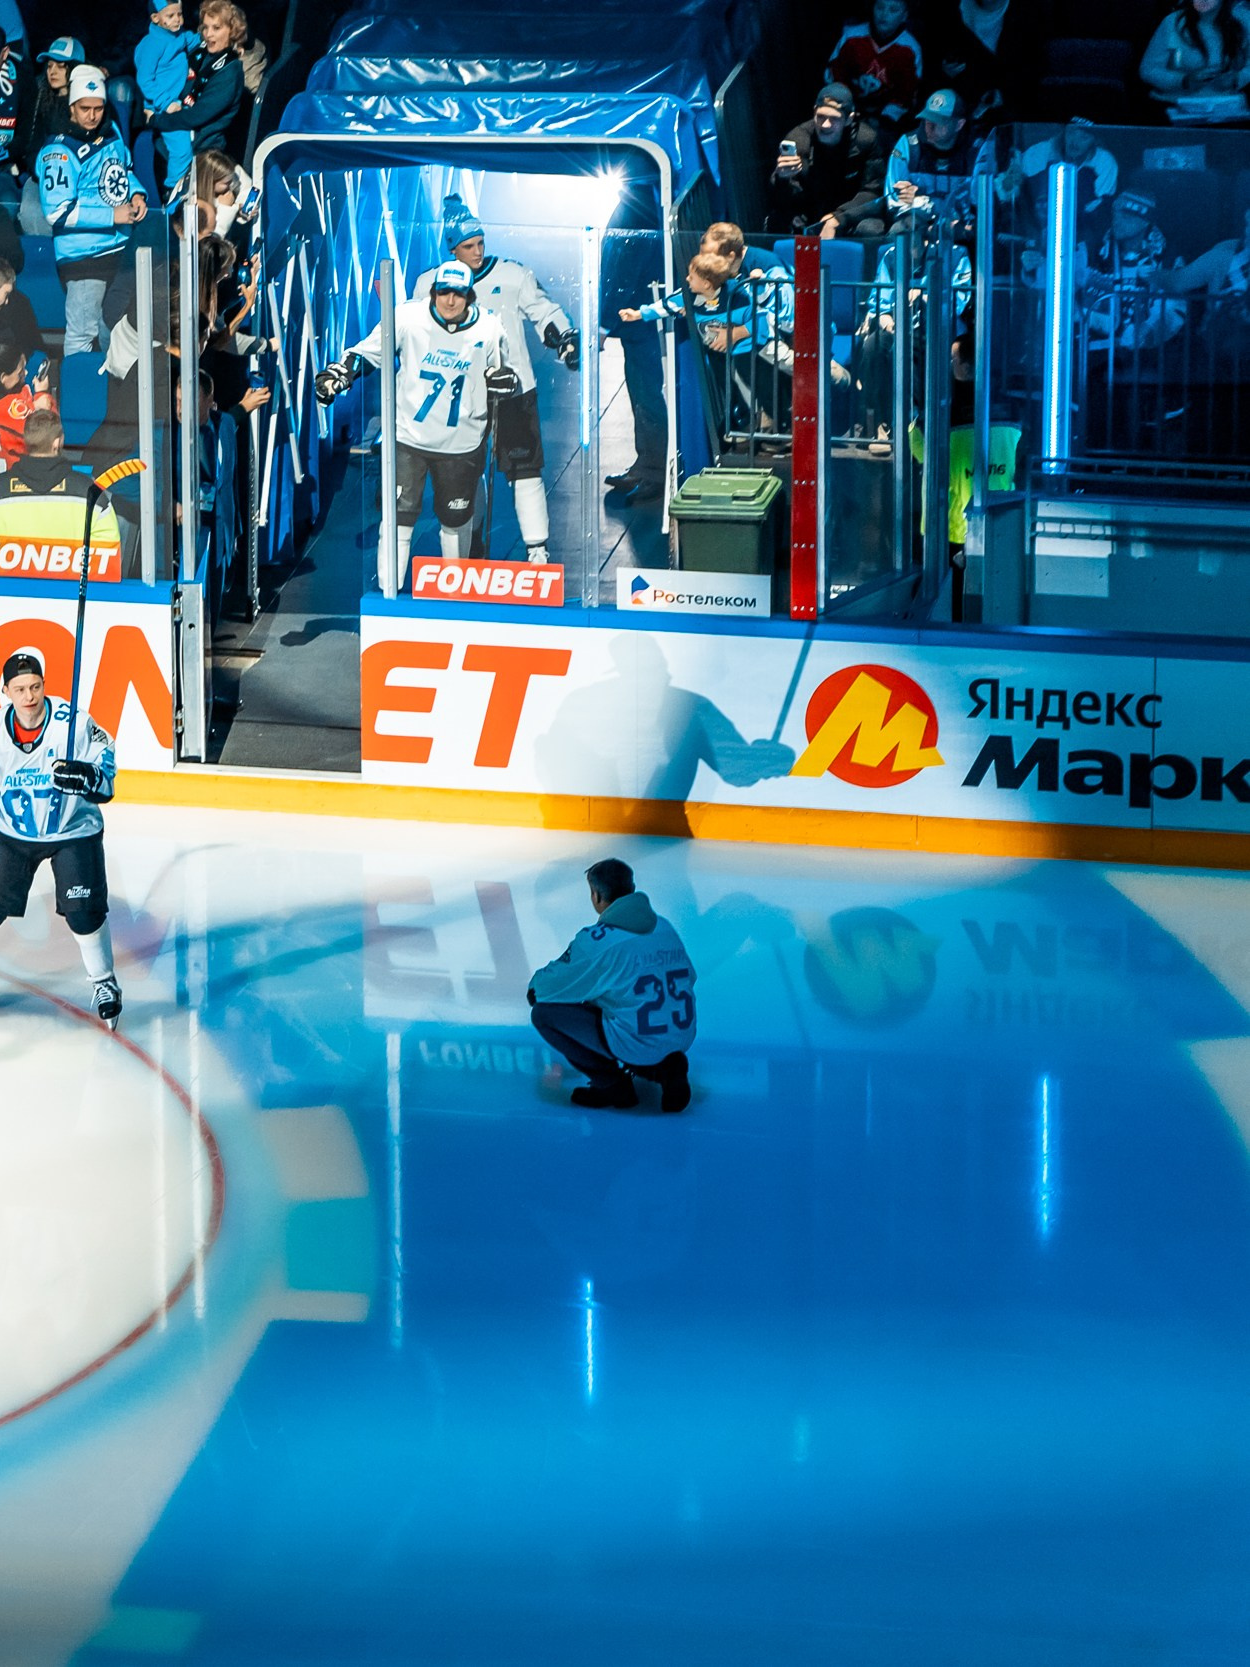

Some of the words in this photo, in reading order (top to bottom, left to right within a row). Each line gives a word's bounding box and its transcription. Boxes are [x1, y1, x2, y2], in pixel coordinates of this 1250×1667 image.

[44, 165, 69, 191] 54
[413, 369, 466, 428] 71
[414, 564, 561, 599] FONBET
[653, 589, 757, 608] Ростелеком
[966, 677, 1163, 730] Яндекс
[1, 787, 63, 839] 97
[633, 968, 694, 1036] 25
